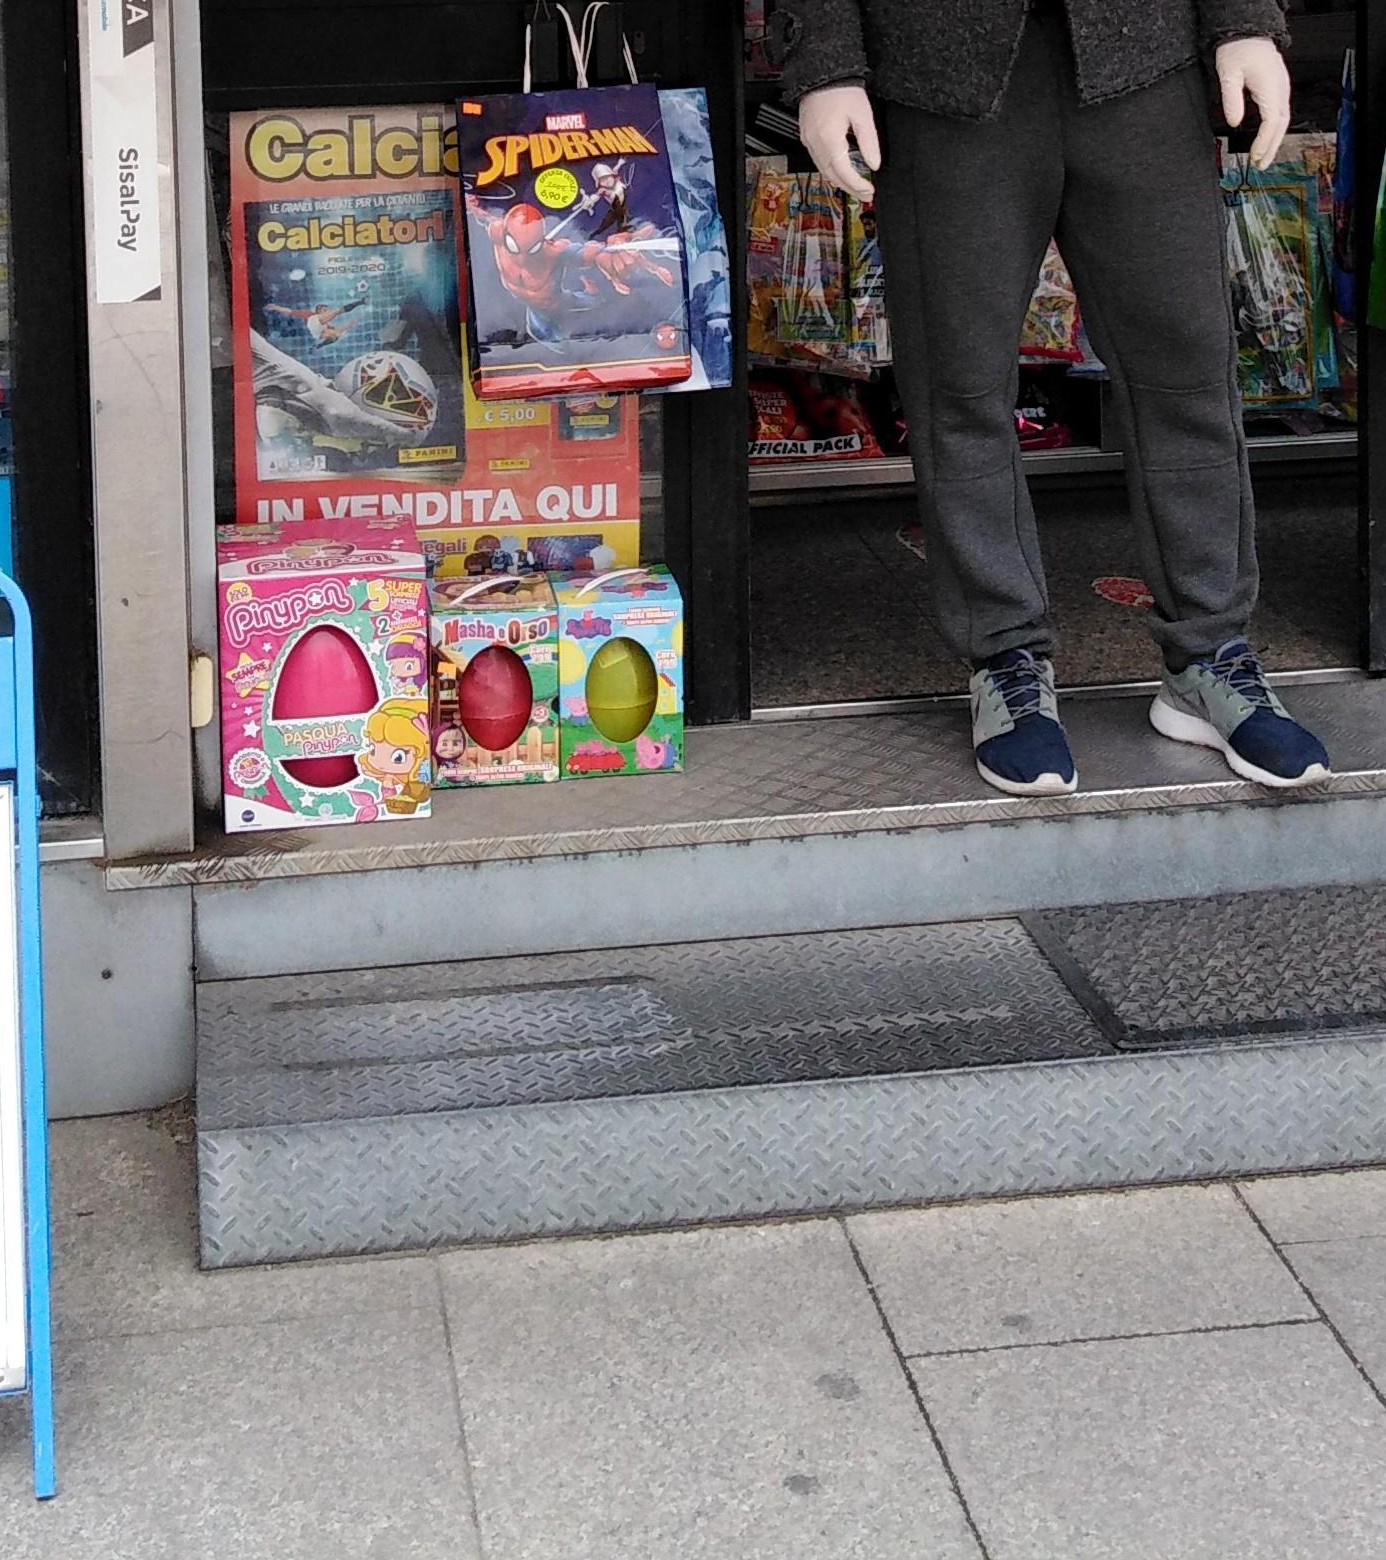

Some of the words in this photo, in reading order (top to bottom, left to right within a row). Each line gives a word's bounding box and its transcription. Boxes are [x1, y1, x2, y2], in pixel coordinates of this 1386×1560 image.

[546, 115, 586, 130] MARVEL
[475, 125, 660, 187] SPIDER-MAN
[117, 147, 140, 253] SisalPay
[258, 209, 446, 253] Calciatori
[317, 263, 387, 276] 2019-2020
[415, 447, 455, 458] PANINI
[747, 440, 807, 456] FFICIAL
[813, 437, 855, 453] PACK
[257, 497, 306, 523] IN
[317, 488, 523, 526] VENDITA
[535, 483, 618, 523] QUI
[367, 578, 390, 611] 5
[385, 580, 423, 594] SUPER
[443, 618, 495, 642] Masha
[231, 662, 268, 682] SEMPRE
[283, 722, 349, 747] PASQUA
